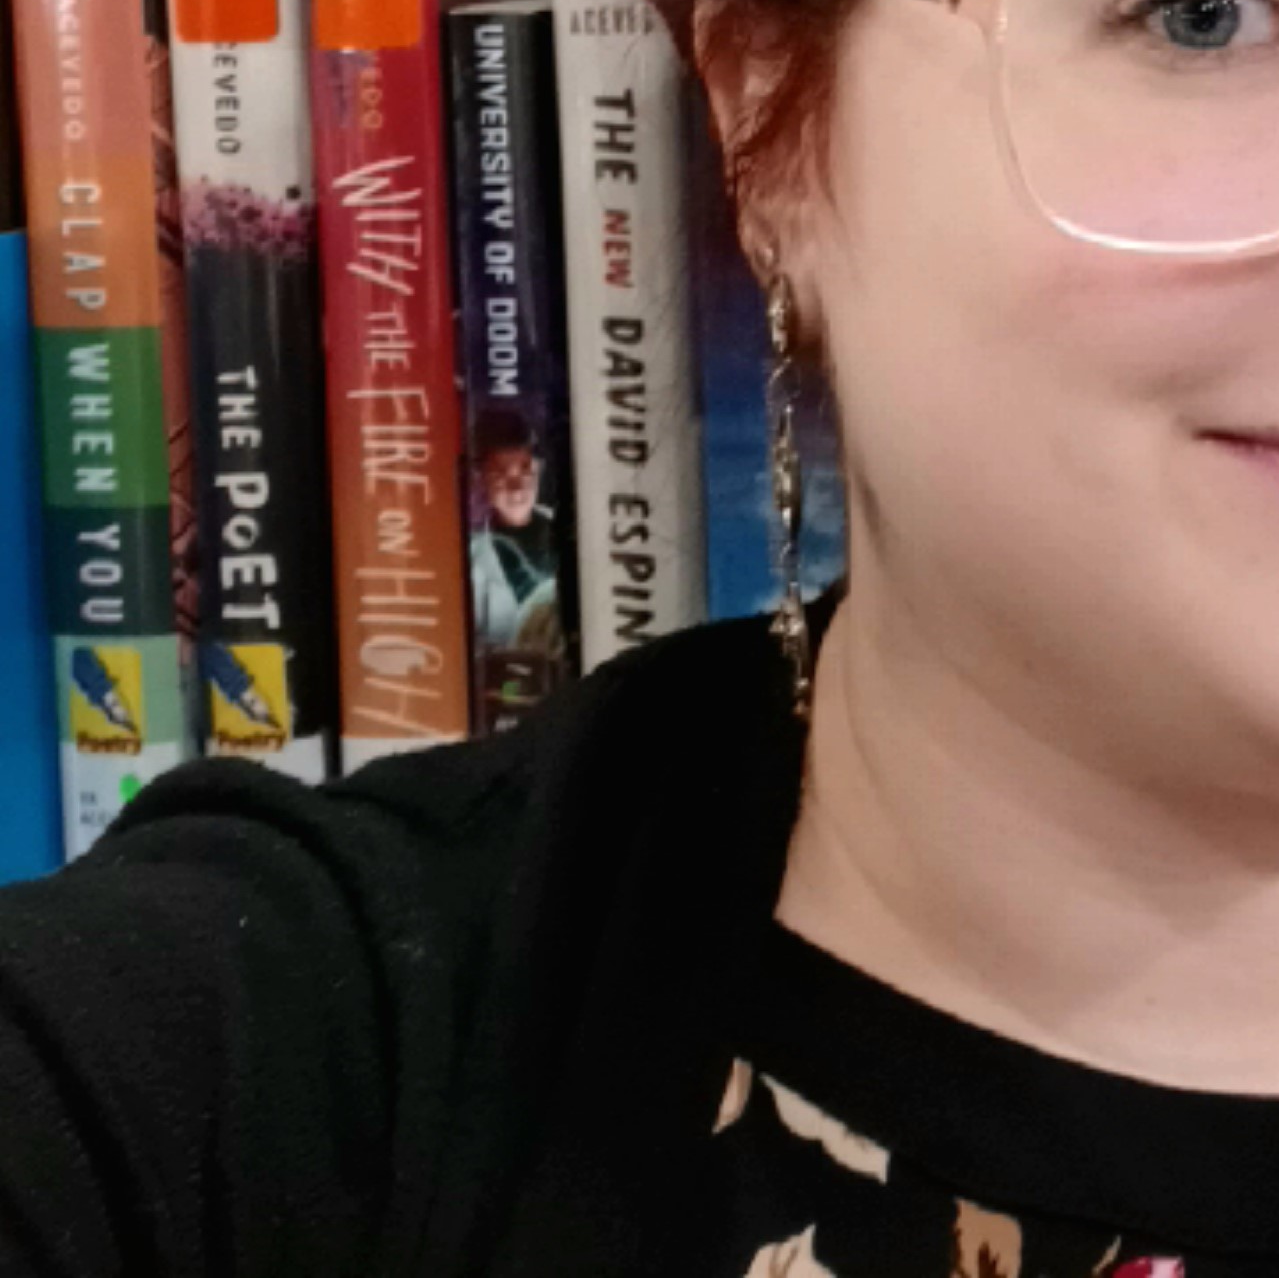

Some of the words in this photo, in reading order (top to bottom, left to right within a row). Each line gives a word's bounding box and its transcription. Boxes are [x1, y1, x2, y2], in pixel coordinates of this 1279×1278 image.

[474, 24, 514, 228] UNIVERSITY
[593, 88, 639, 185] THE
[59, 182, 107, 312] CLAP
[332, 156, 423, 296] WITH
[483, 241, 516, 284] OF
[602, 209, 634, 290] NEW
[364, 303, 416, 370] THE
[486, 297, 519, 397] DOOM
[67, 341, 118, 492] WHEN
[218, 366, 263, 450] THE
[602, 316, 651, 470] DAVID
[346, 385, 431, 506] FIRE
[79, 523, 124, 624] YOU
[376, 509, 422, 558] ON
[607, 492, 657, 644] ESPIN
